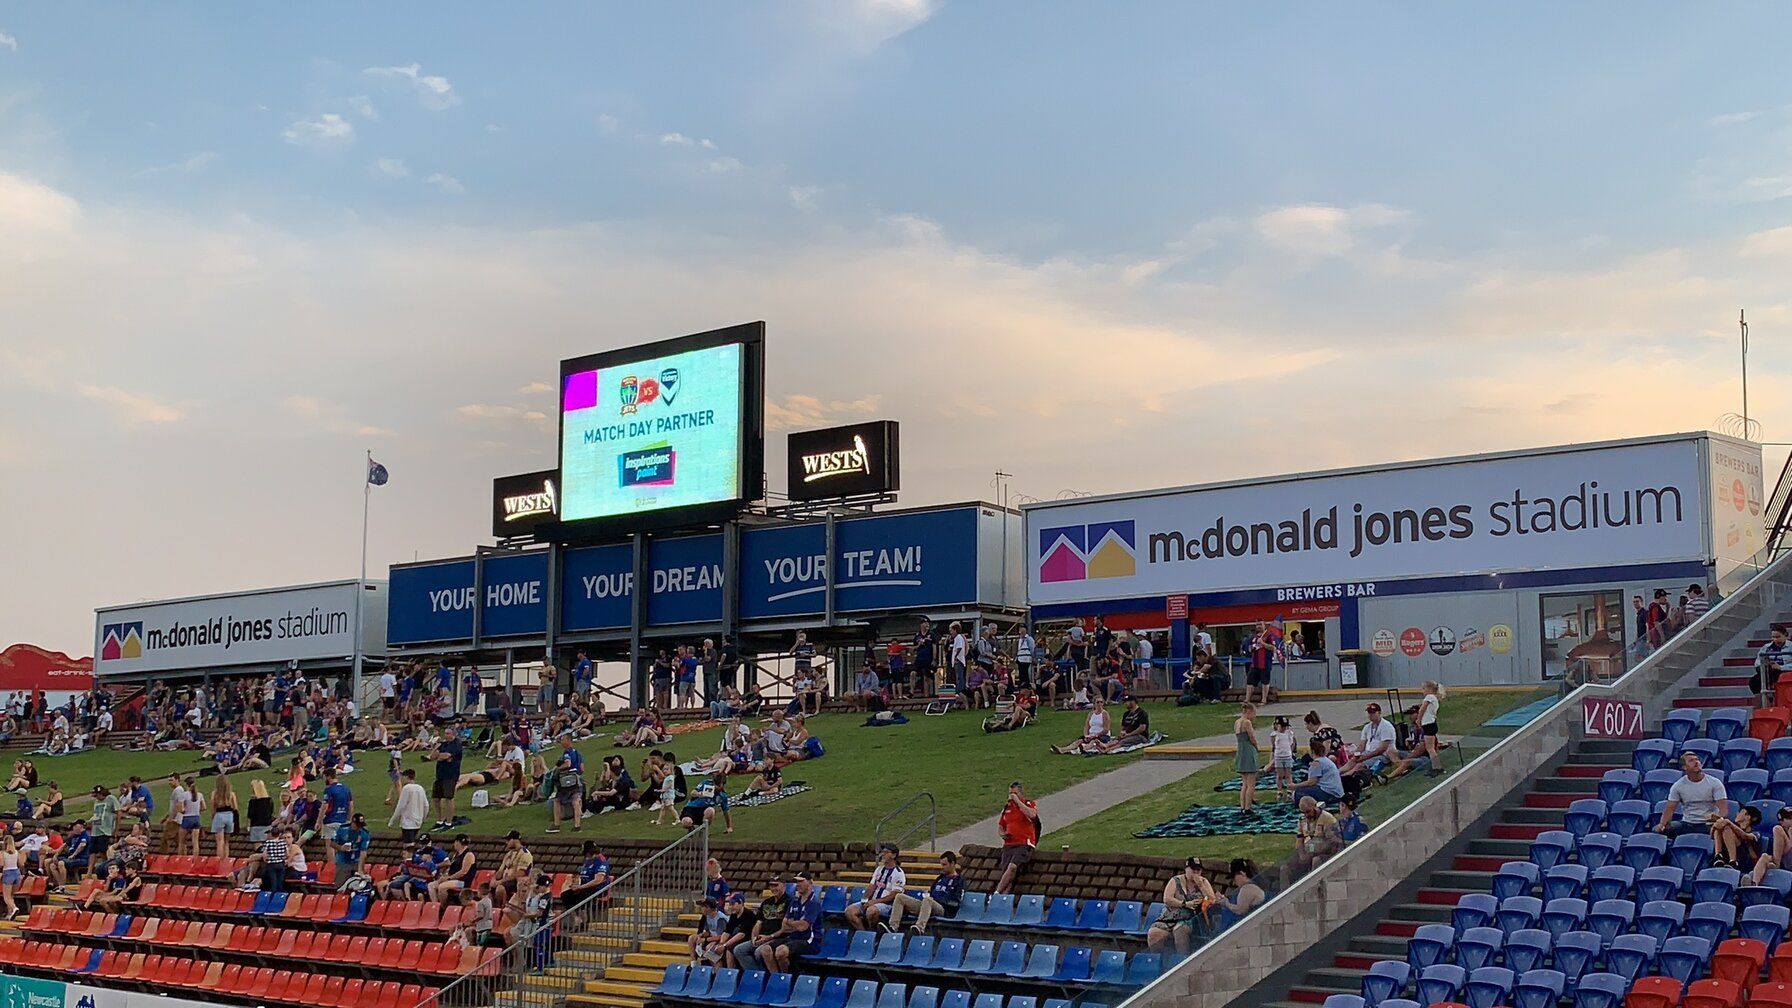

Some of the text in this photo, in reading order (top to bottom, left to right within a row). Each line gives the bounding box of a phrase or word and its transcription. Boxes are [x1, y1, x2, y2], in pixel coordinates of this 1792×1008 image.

[643, 386, 654, 396] VS
[584, 410, 714, 444] MATCH DAY PARTNER
[625, 453, 670, 470] inspirations
[803, 450, 863, 474] WESTS
[1715, 452, 1760, 478] BREWERS BAR
[503, 492, 551, 514] WESTS
[1349, 503, 1474, 558] jones
[1489, 481, 1682, 537] stadium
[764, 546, 921, 584] YOUR TEAM!
[429, 581, 540, 612] YOUR HOME
[1277, 583, 1375, 601] BREWERS BAR
[1318, 605, 1339, 613] GROUP
[225, 615, 272, 649] jones
[277, 607, 347, 638] stadium
[1604, 702, 1625, 736] 60
